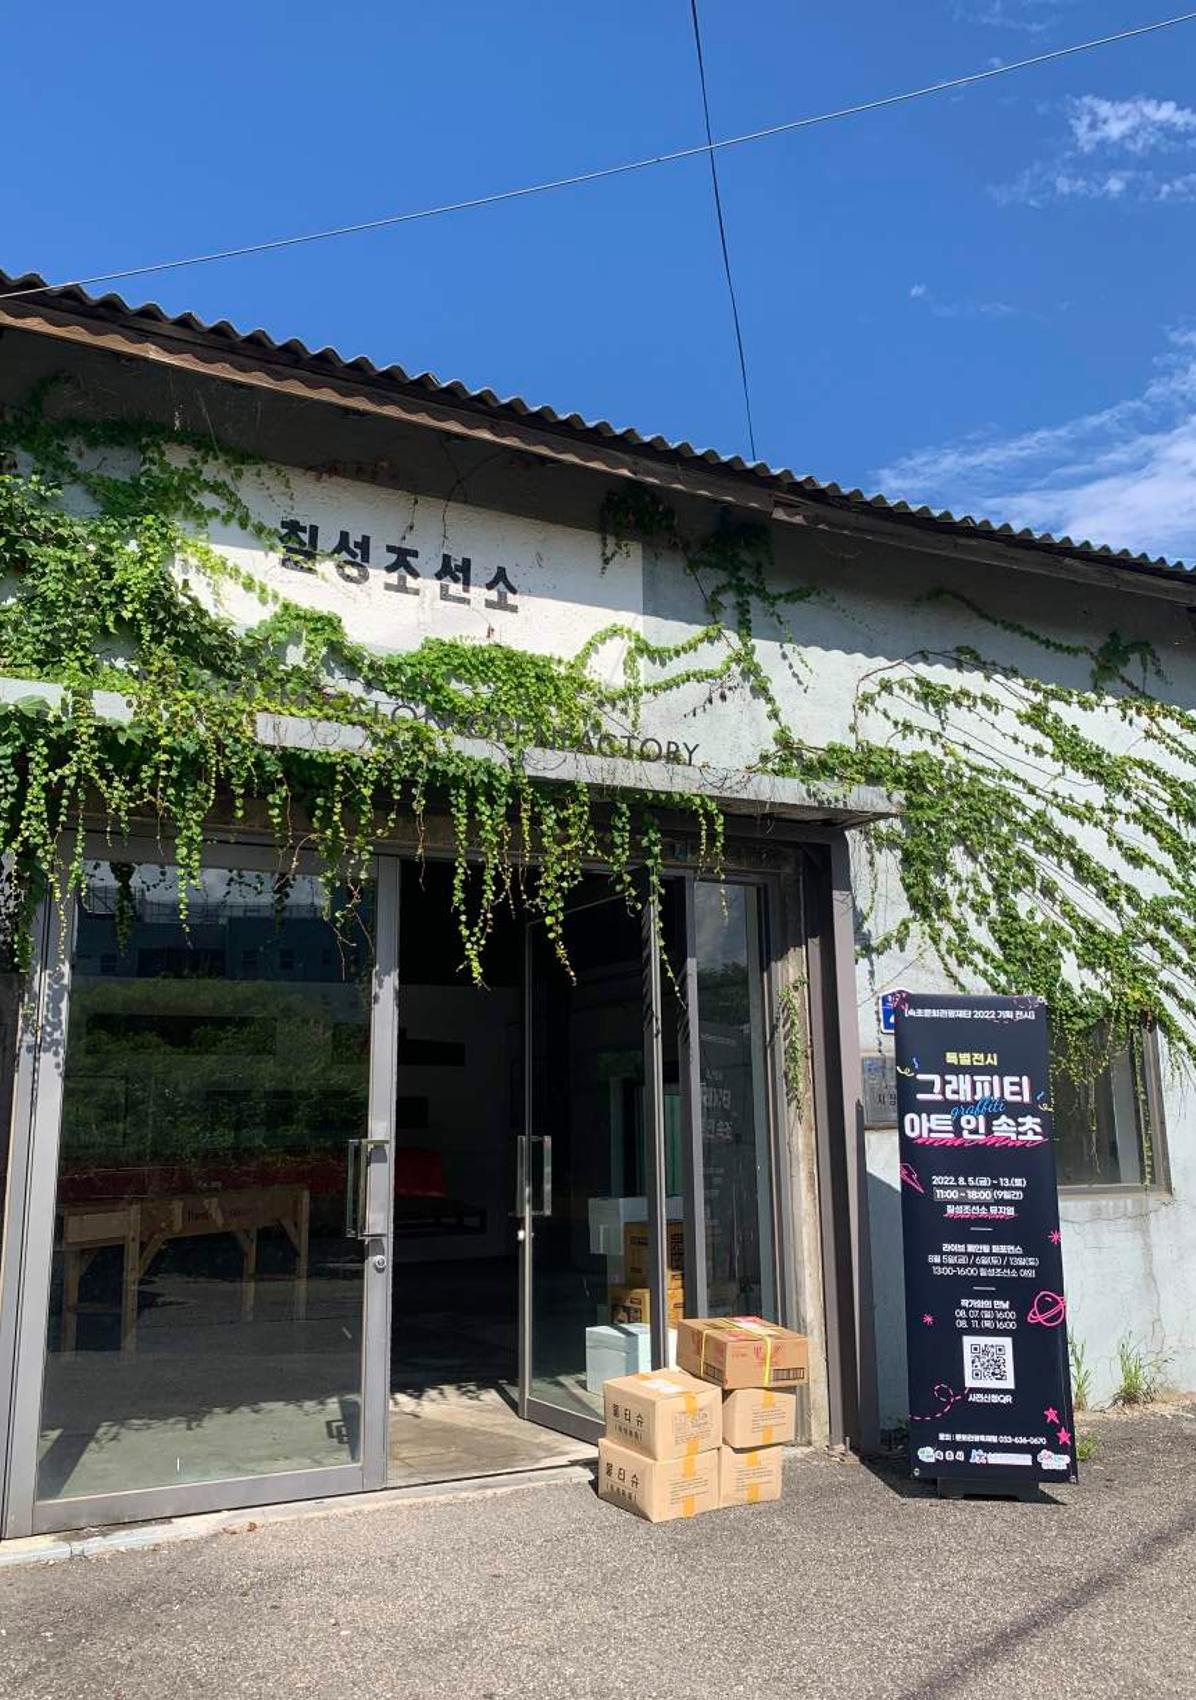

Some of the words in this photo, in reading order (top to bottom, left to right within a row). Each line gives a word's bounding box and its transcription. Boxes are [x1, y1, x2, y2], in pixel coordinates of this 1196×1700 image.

[280, 519, 519, 613] 칠성조선소
[973, 1009, 996, 1019] 2022
[945, 1052, 998, 1066] 특별전시
[916, 1074, 1031, 1102] 그래피티
[903, 1113, 955, 1139] 아트
[960, 1115, 986, 1139] 인
[992, 1115, 1044, 1141] 속초
[936, 1189, 959, 1199] 11:00
[946, 1204, 988, 1214] 칠성조선소
